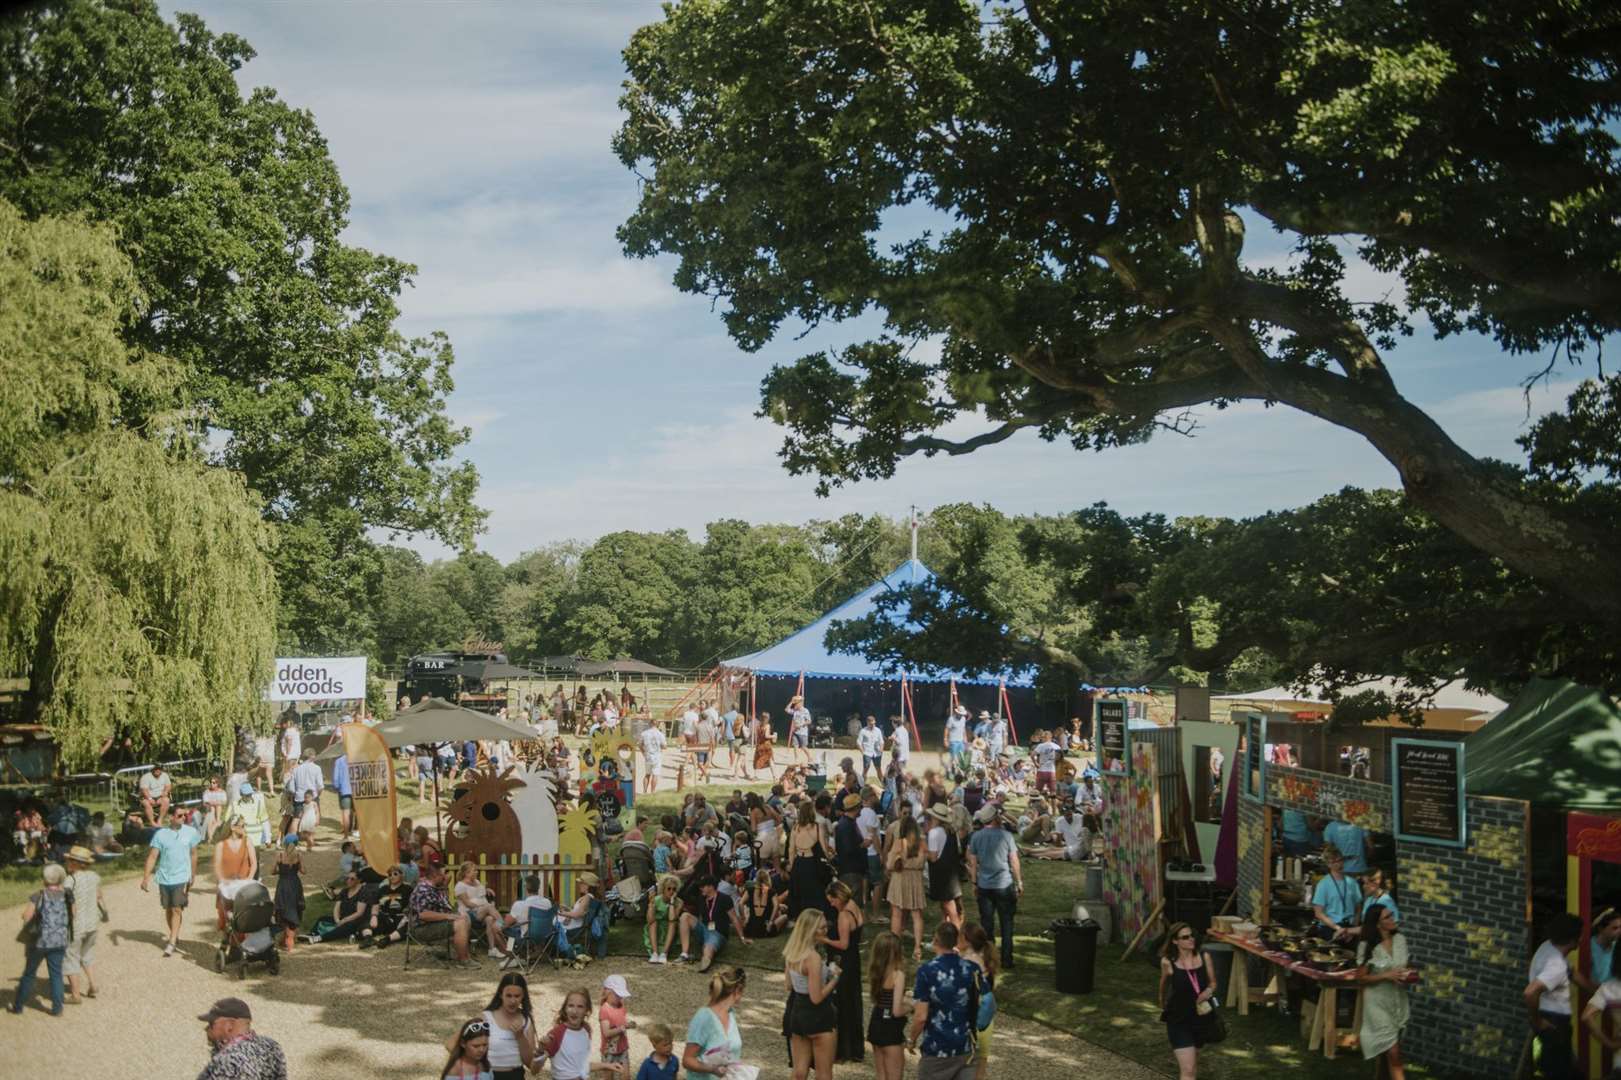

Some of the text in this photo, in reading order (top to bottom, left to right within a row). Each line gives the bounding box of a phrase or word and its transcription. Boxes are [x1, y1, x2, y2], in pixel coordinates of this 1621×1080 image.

[273, 664, 328, 681] dden
[424, 661, 445, 669] BAR
[278, 677, 344, 695] woods
